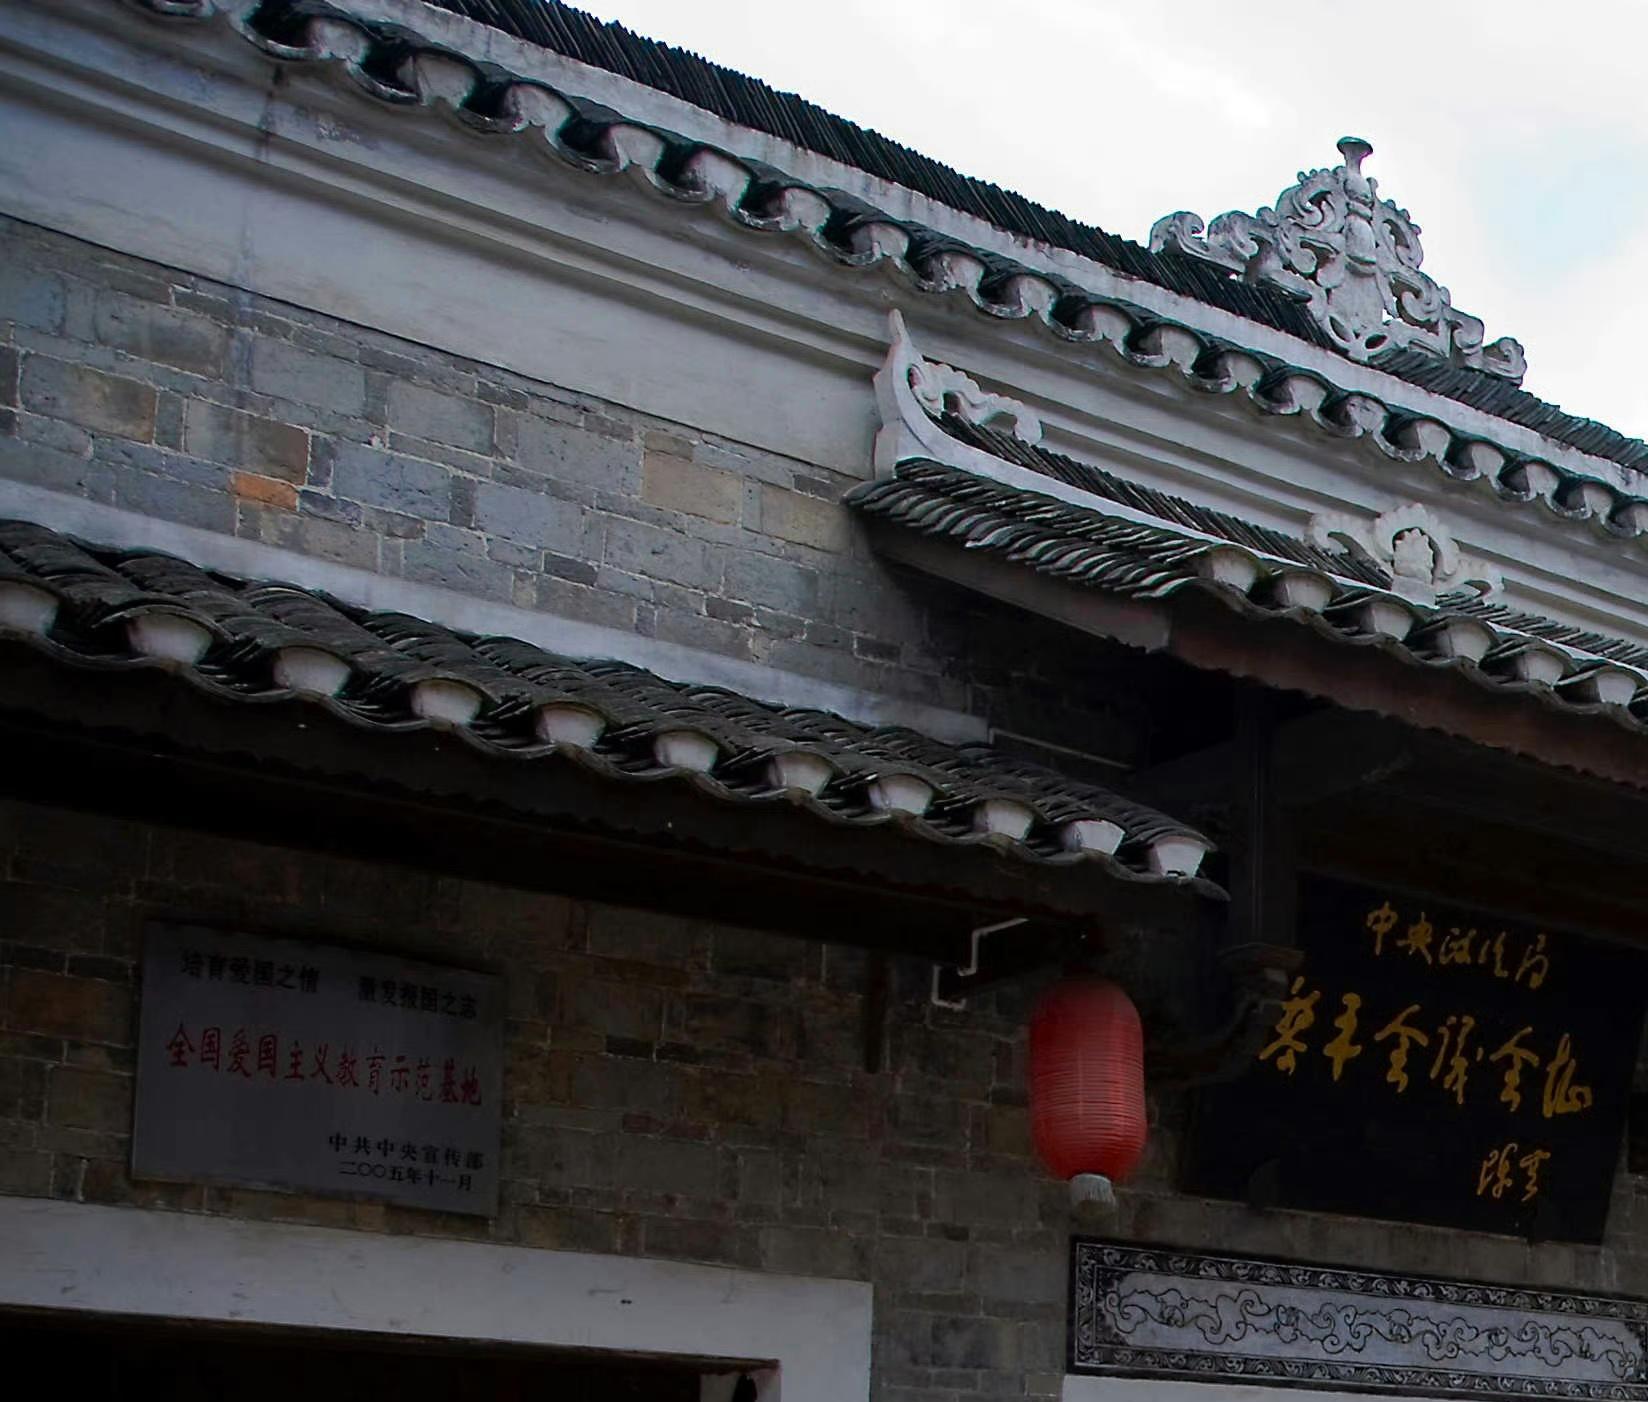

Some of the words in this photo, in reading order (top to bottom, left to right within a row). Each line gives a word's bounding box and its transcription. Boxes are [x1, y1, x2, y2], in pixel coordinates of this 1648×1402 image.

[165, 1023, 483, 1107] 全国爱国主义教育示范基地
[328, 1131, 485, 1171] 中共中央宣传部
